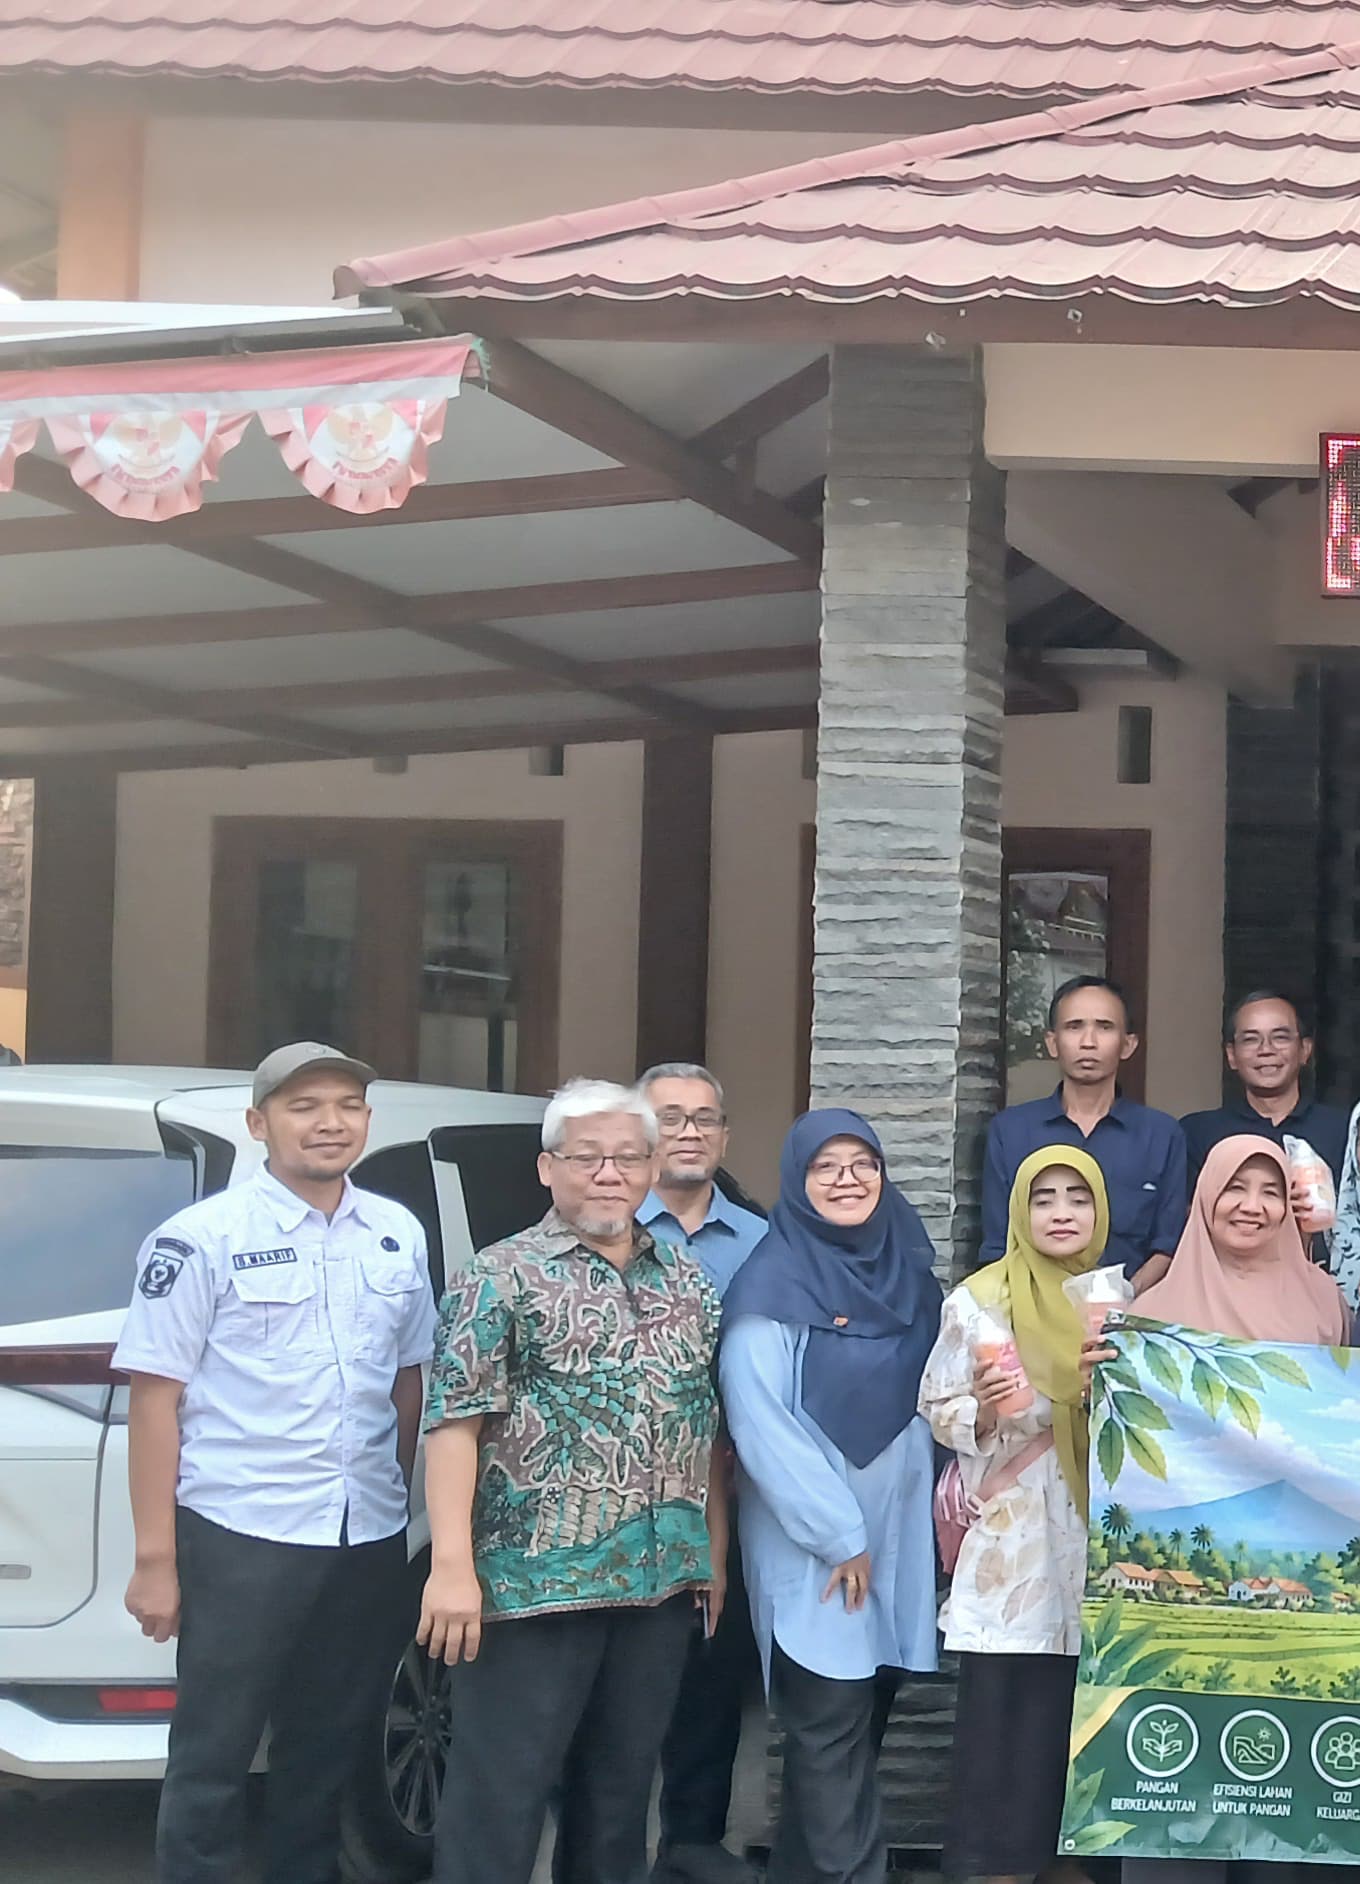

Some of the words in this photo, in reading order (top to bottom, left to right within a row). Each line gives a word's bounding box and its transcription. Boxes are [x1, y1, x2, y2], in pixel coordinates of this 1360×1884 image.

[1135, 1780, 1178, 1794] PANGAN
[1213, 1783, 1257, 1797] EFISIENSI
[1259, 1785, 1292, 1799] LAHAN
[1110, 1797, 1197, 1813] BERKELANJUTAN
[1332, 1791, 1352, 1803] GIZI
[1212, 1801, 1246, 1815] UNTUK
[1249, 1803, 1291, 1817] PANGAN
